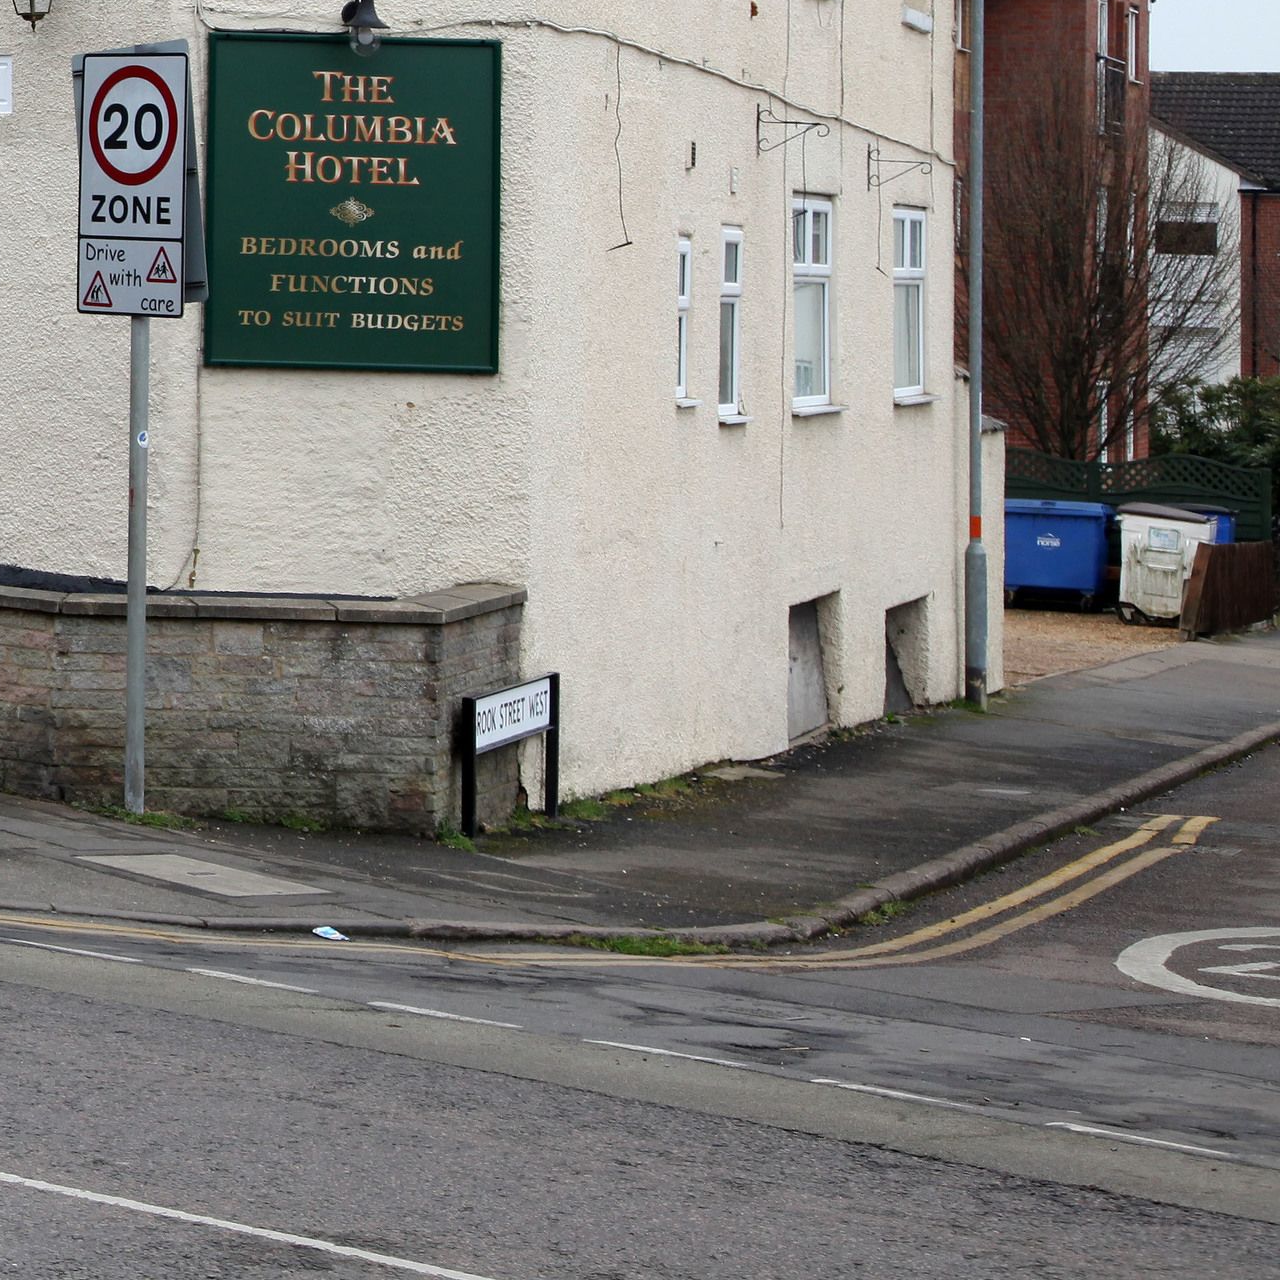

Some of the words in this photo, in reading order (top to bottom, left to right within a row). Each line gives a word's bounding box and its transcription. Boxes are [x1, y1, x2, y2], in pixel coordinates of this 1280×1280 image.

[312, 71, 395, 104] THE
[104, 103, 163, 150] 20
[247, 109, 457, 145] COLUMBIA
[284, 151, 421, 185] HOTEL
[91, 194, 171, 225] ZONE
[86, 242, 126, 262] Drive
[239, 237, 400, 259] BEDROOMS
[412, 240, 464, 260] and
[109, 268, 142, 288] with
[269, 273, 435, 296] FUNCTIONS
[140, 298, 175, 312] care
[238, 310, 271, 327] TO
[282, 311, 340, 328] SUIT
[350, 312, 465, 332] BUDGETS
[476, 706, 496, 735] ROOK
[500, 697, 525, 729] STREET
[529, 690, 548, 718] WEST
